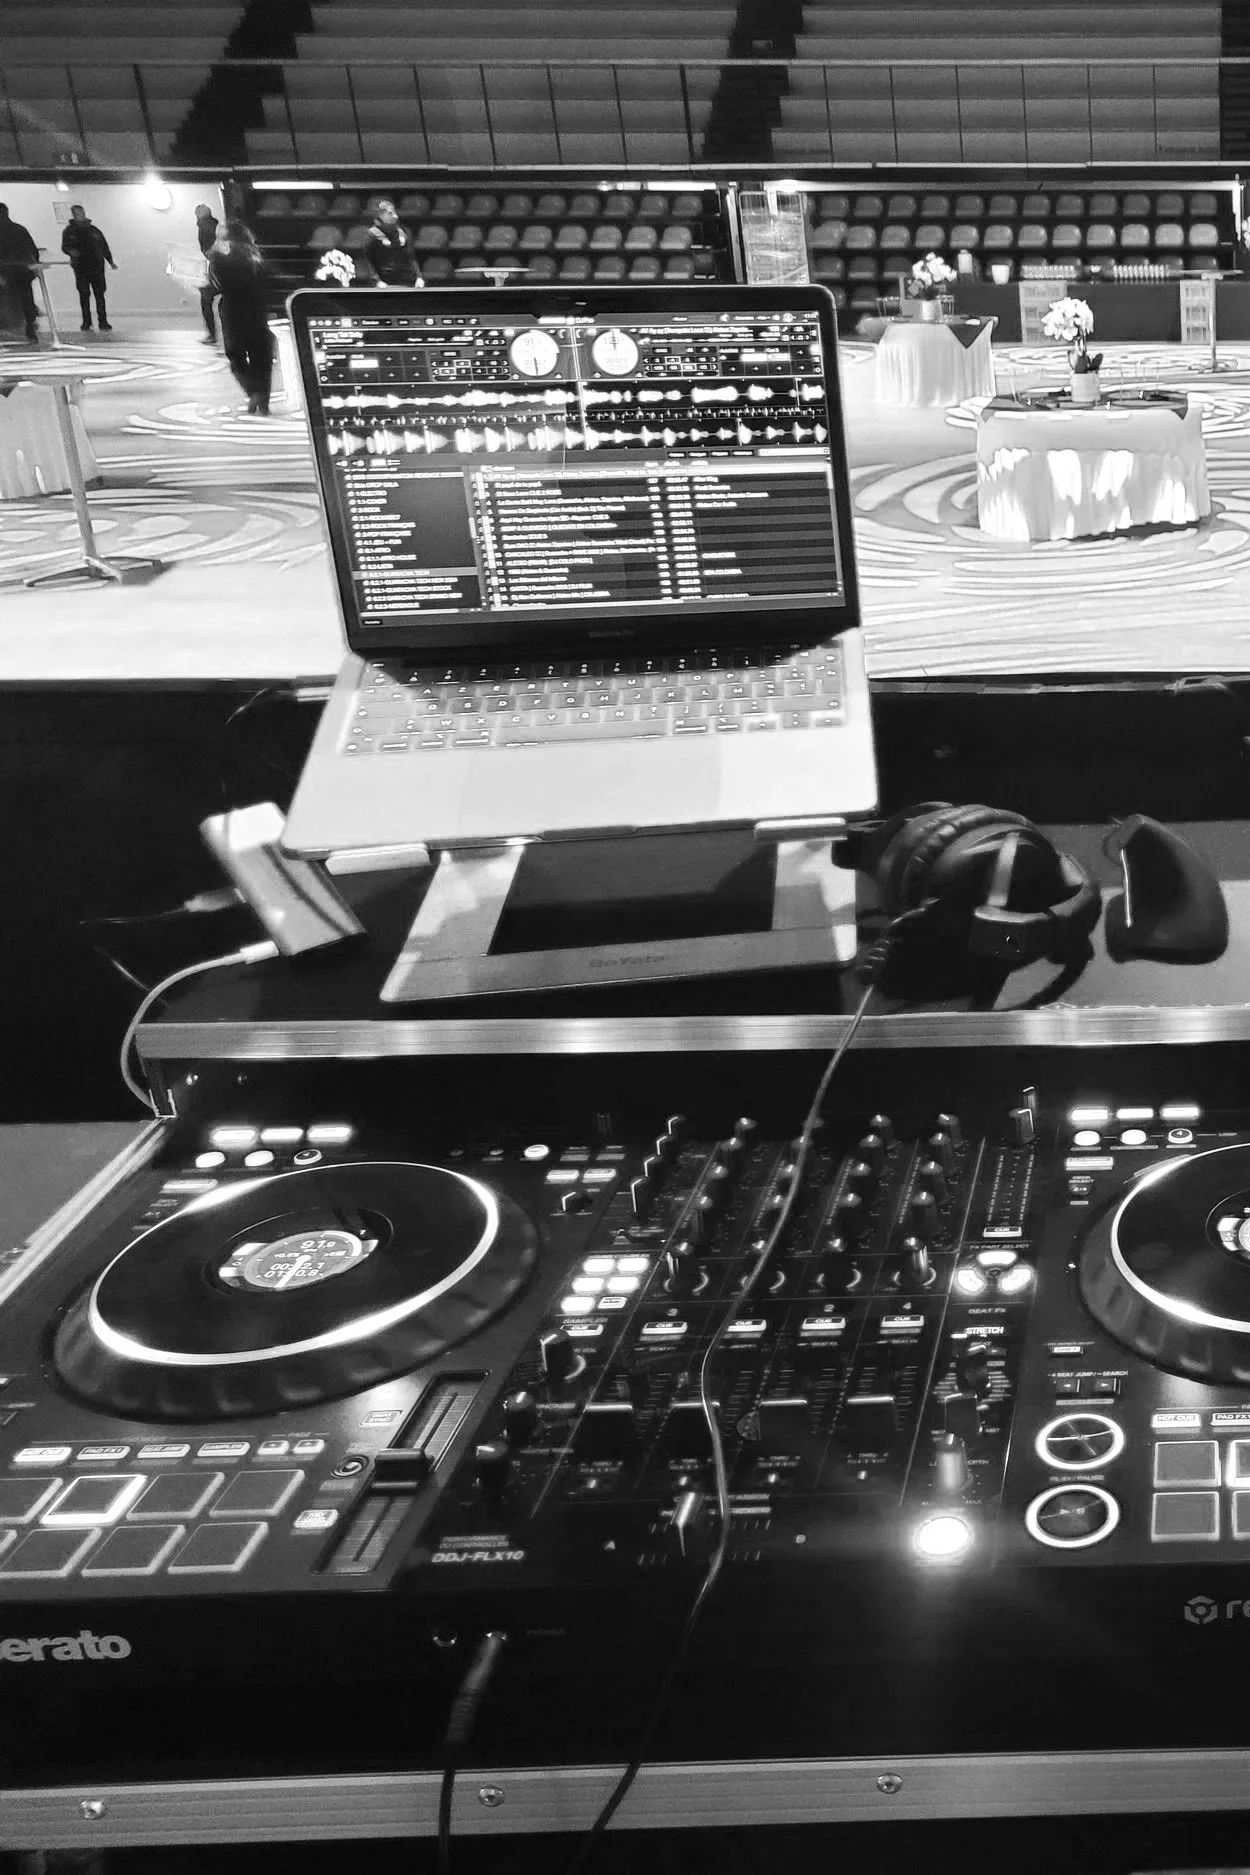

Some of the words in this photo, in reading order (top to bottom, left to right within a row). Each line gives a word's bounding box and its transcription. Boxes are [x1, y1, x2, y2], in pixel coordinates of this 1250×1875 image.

[965, 1326, 1004, 1335] STRETCH
[203, 1443, 244, 1452] SAMPLER
[432, 1551, 525, 1562] DDJ-FLX10
[0, 1630, 132, 1662] erato
